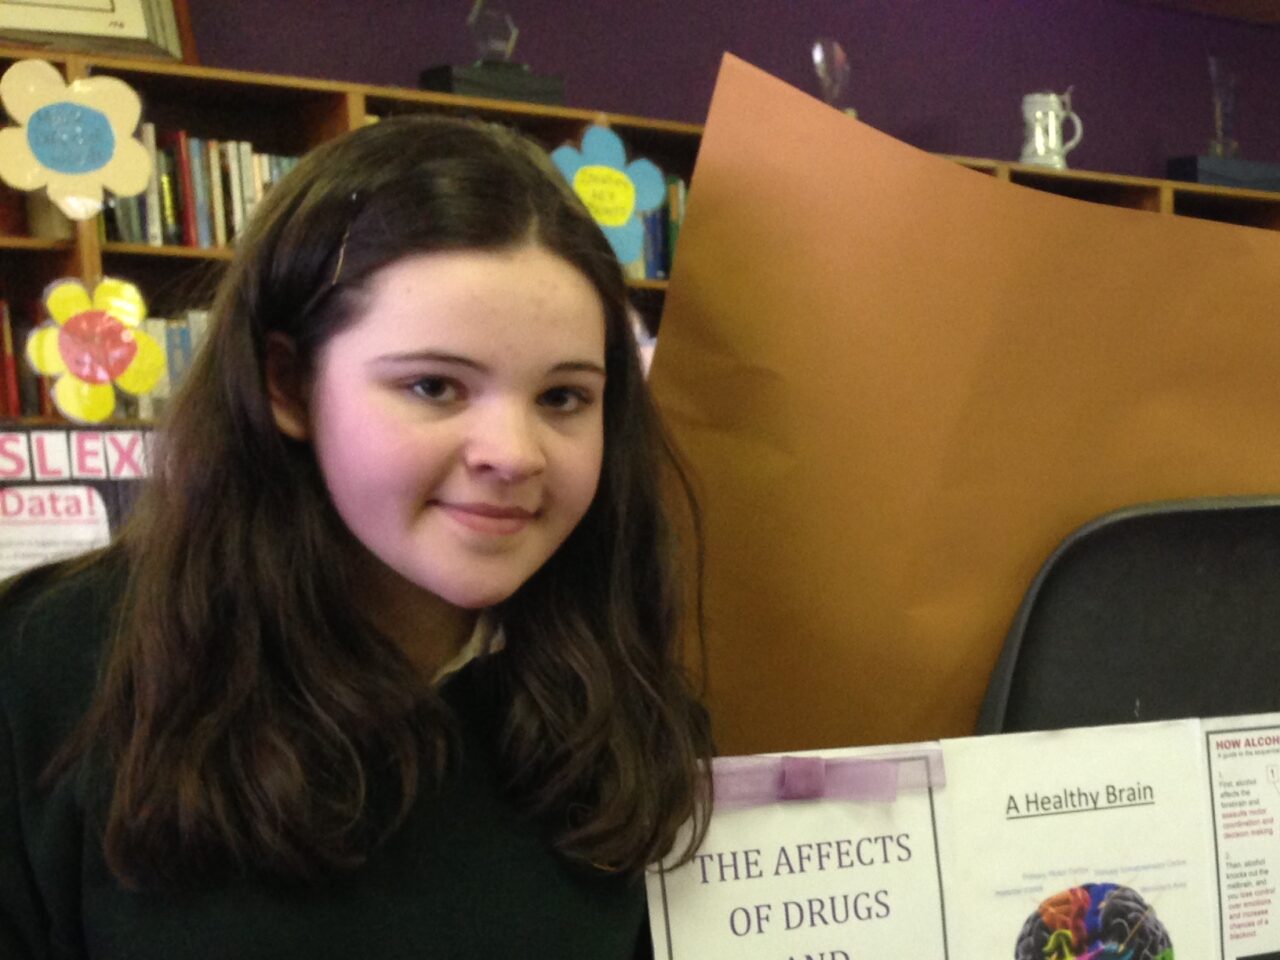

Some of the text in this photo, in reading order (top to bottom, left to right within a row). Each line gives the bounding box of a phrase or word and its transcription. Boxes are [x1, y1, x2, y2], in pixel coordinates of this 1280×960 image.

[1216, 738, 1241, 751] HOW
[1006, 782, 1155, 815] A Healthy Brain
[694, 833, 913, 885] THE AFFECTS
[729, 889, 891, 938] OF DRUGS
